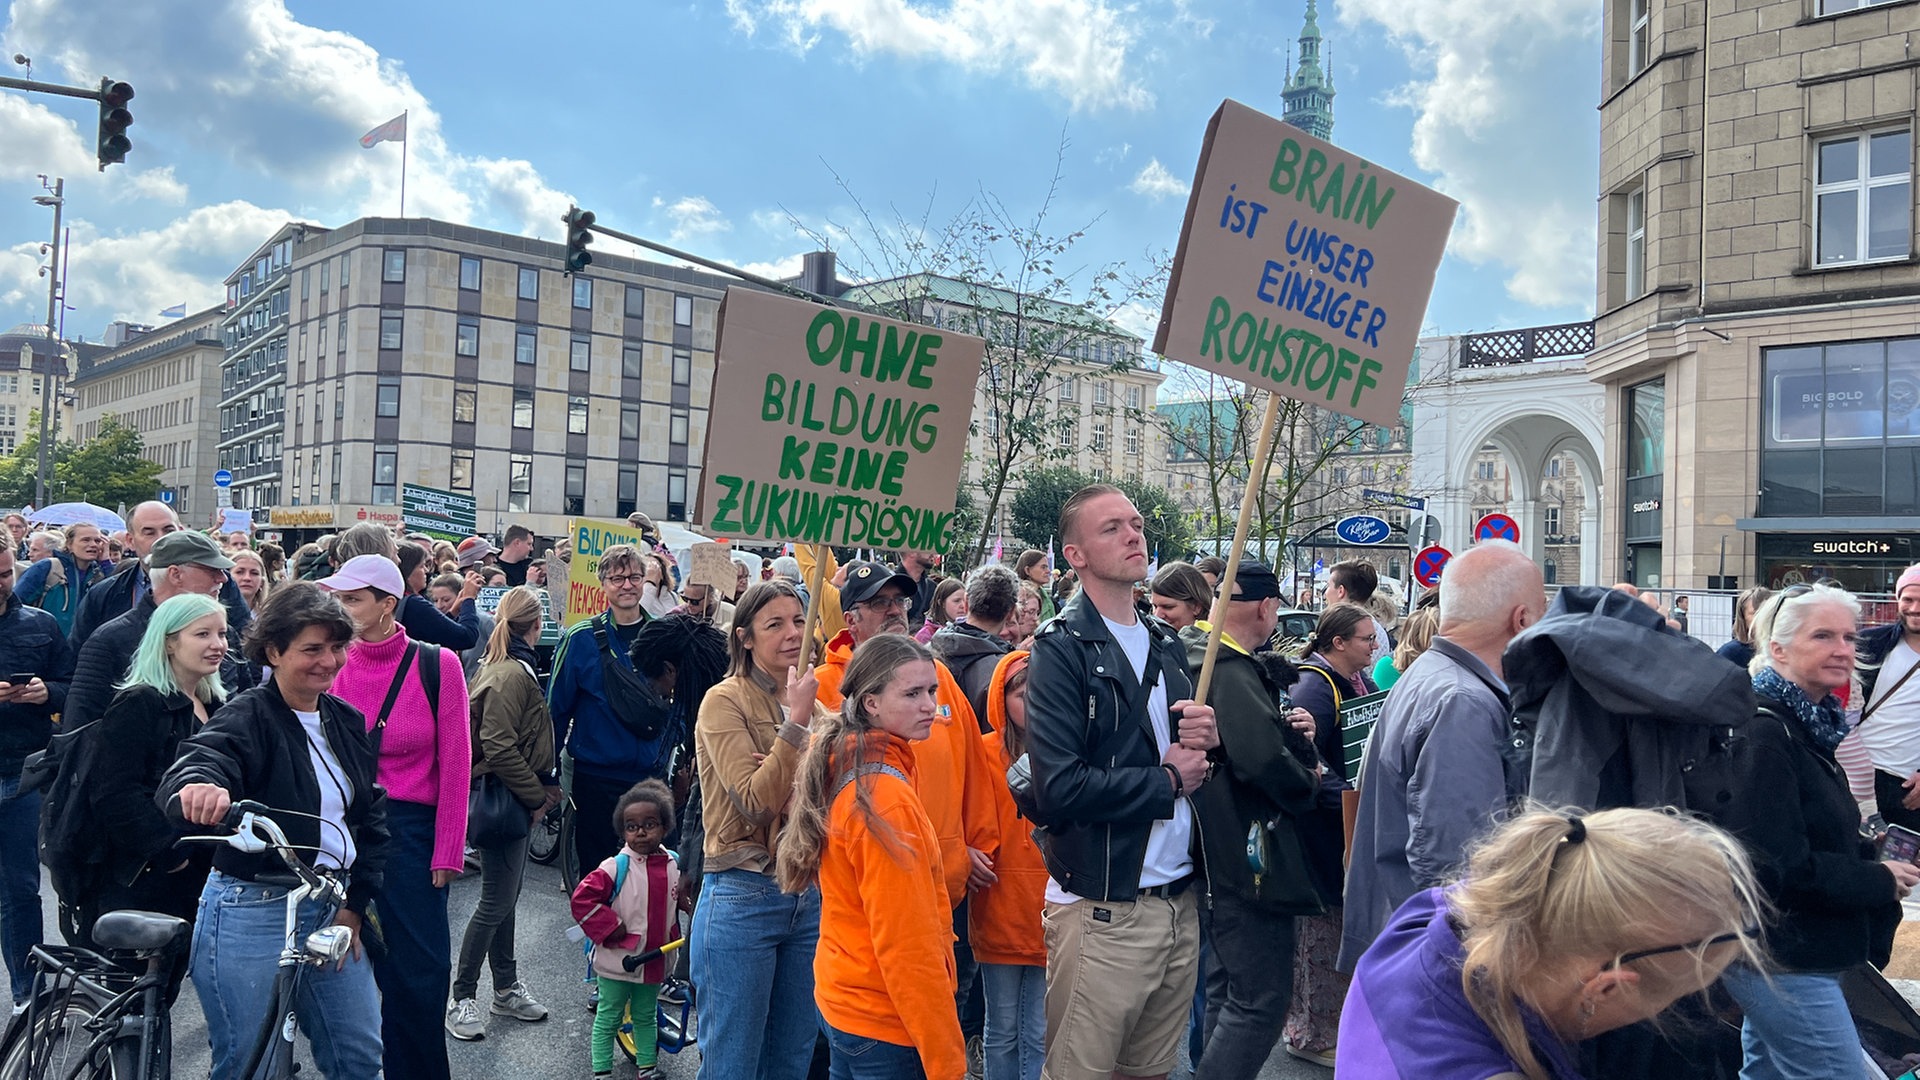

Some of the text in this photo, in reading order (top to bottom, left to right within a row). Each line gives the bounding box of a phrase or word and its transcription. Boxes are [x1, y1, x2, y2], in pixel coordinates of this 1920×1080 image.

[1285, 219, 1375, 288] UNSER
[806, 309, 943, 390] OHNE
[1200, 295, 1384, 408] ROHSTOFF
[761, 373, 940, 454] BILDUNG
[1802, 391, 1864, 403] BIG BOLD
[778, 435, 909, 497] KEINE
[162, 492, 173, 504] U
[370, 511, 398, 521] Haspa
[710, 474, 955, 555] ZUKUNFTSLÖSUNG
[577, 527, 637, 556] BILD
[587, 560, 597, 572] ist
